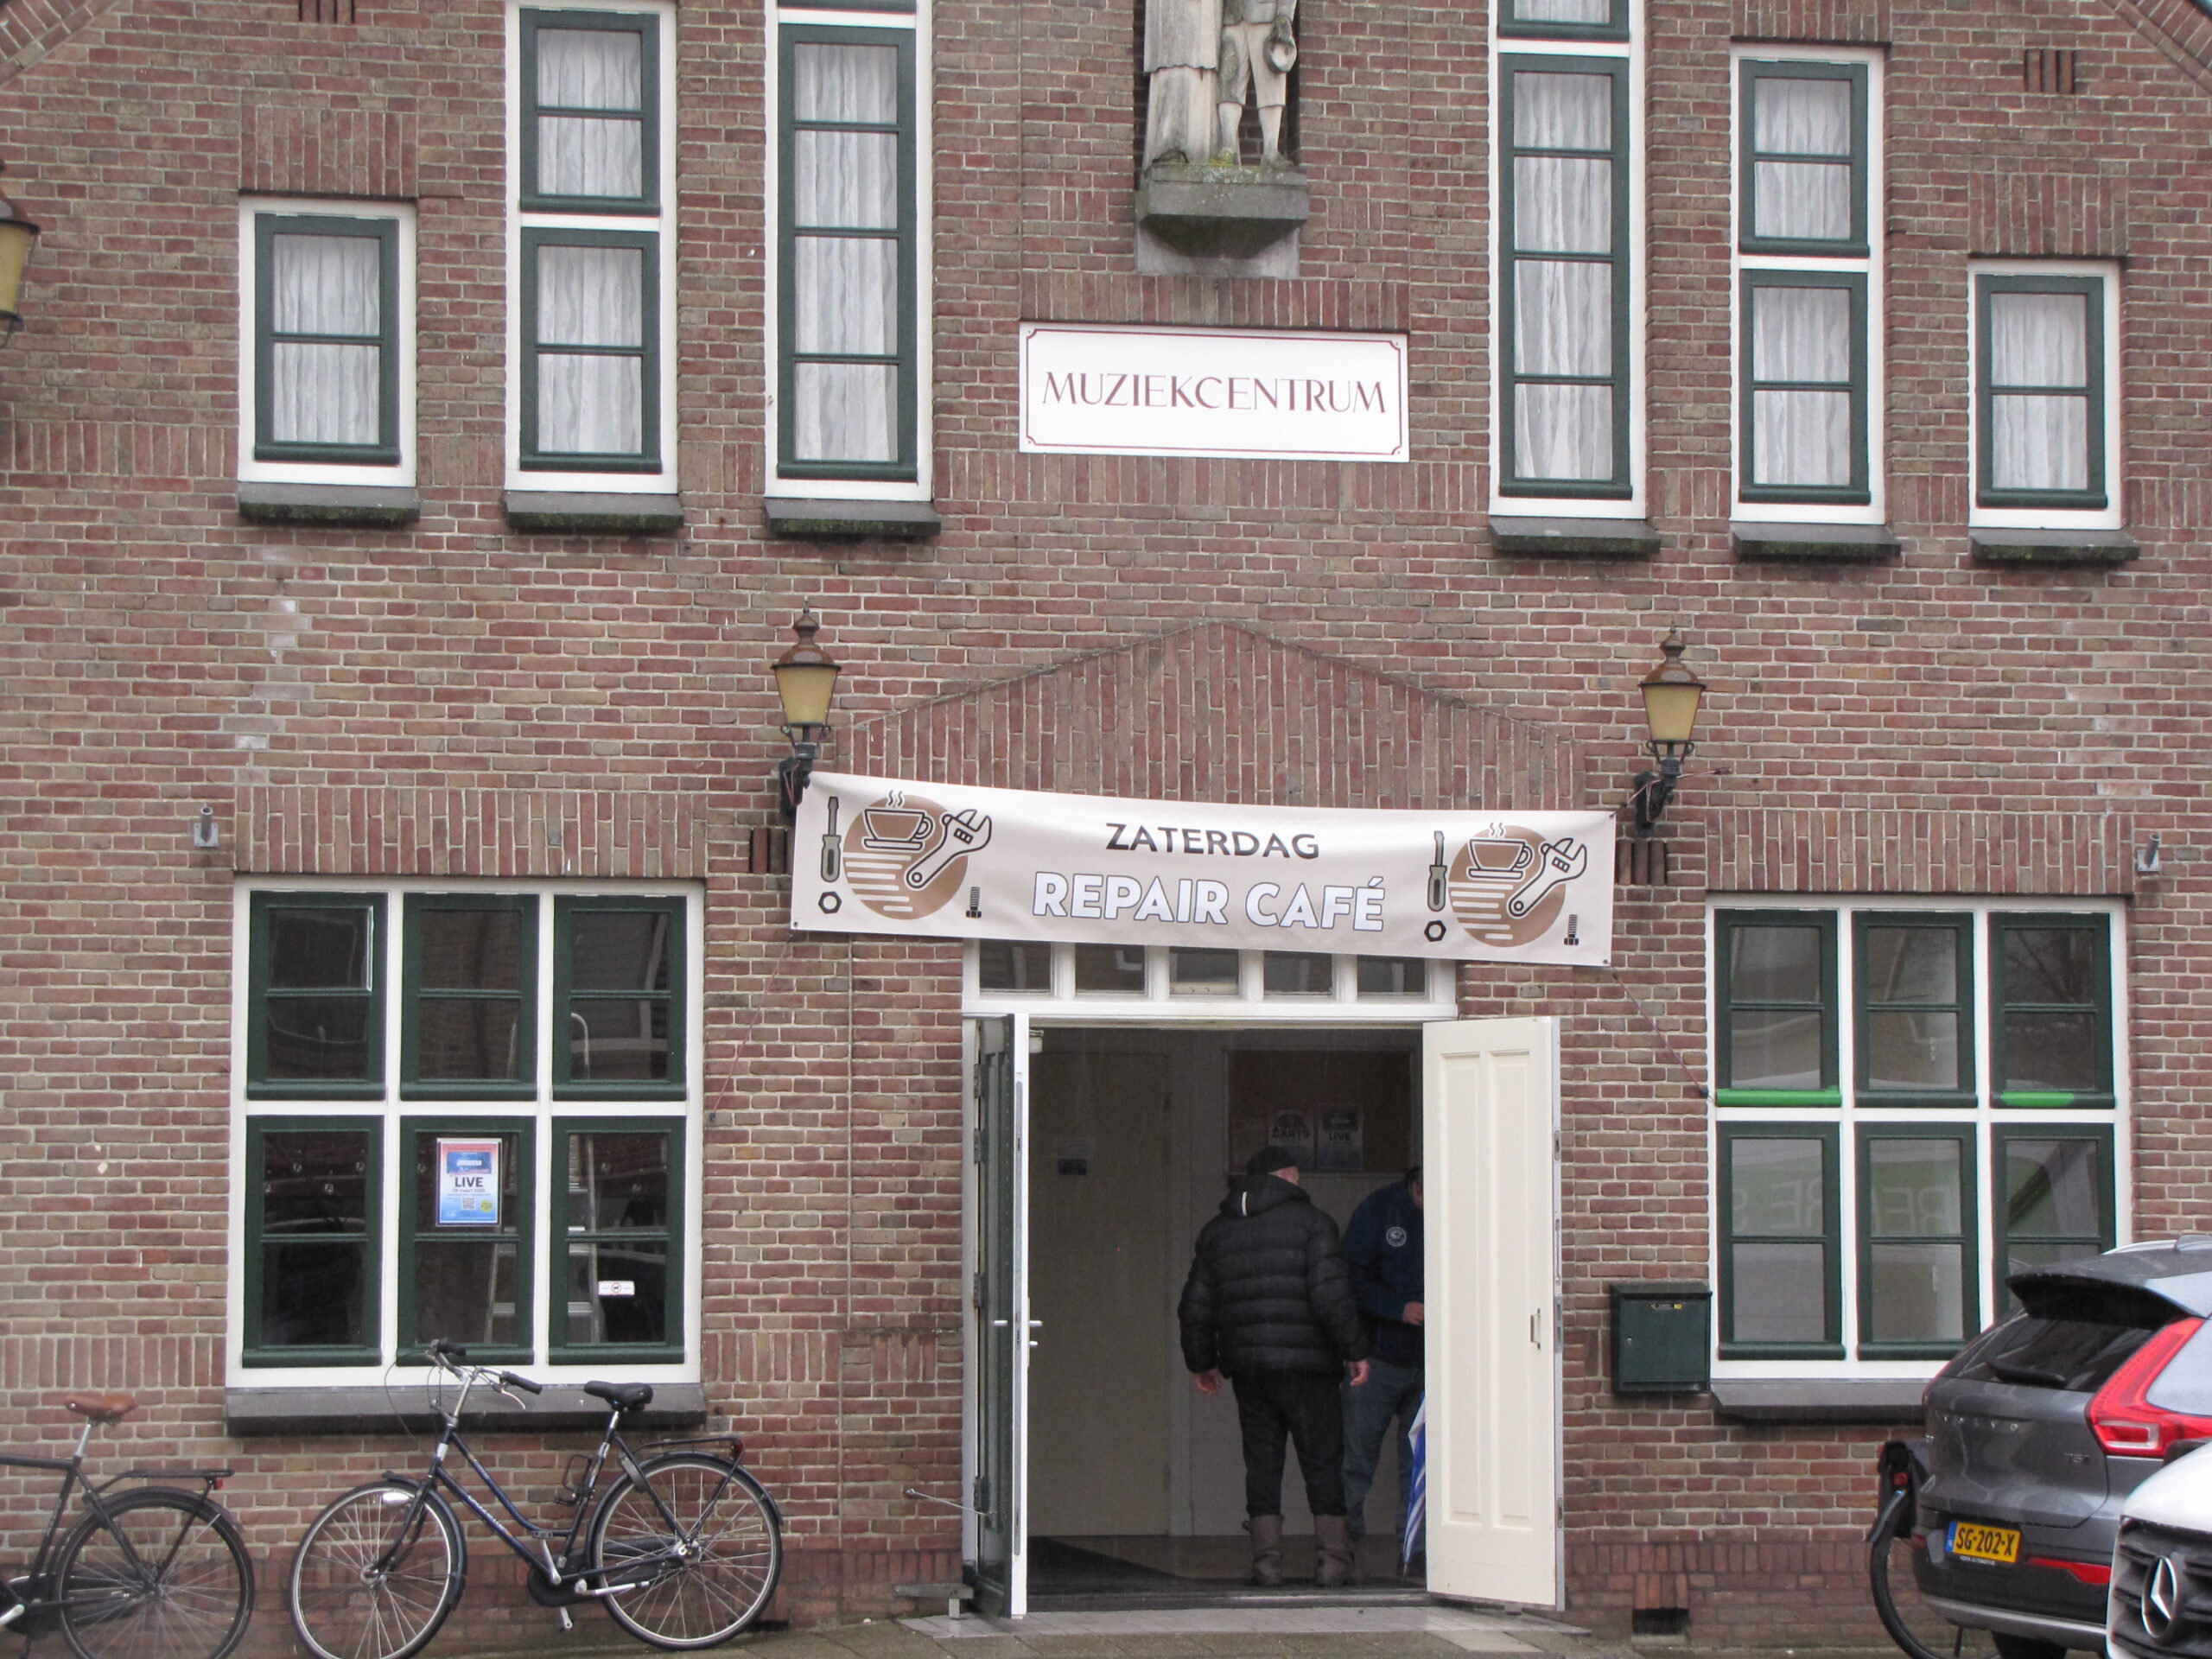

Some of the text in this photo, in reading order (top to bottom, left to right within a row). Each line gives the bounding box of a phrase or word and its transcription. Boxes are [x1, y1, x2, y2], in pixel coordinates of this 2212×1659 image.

[1042, 372, 1386, 413] MUZIEKCENTRUM
[1106, 823, 1319, 859] ZATERDAG
[1033, 871, 1386, 932] REPAIR CAFÉ
[454, 1177, 483, 1187] LIVE
[1956, 1527, 2015, 1556] SG-202-X
